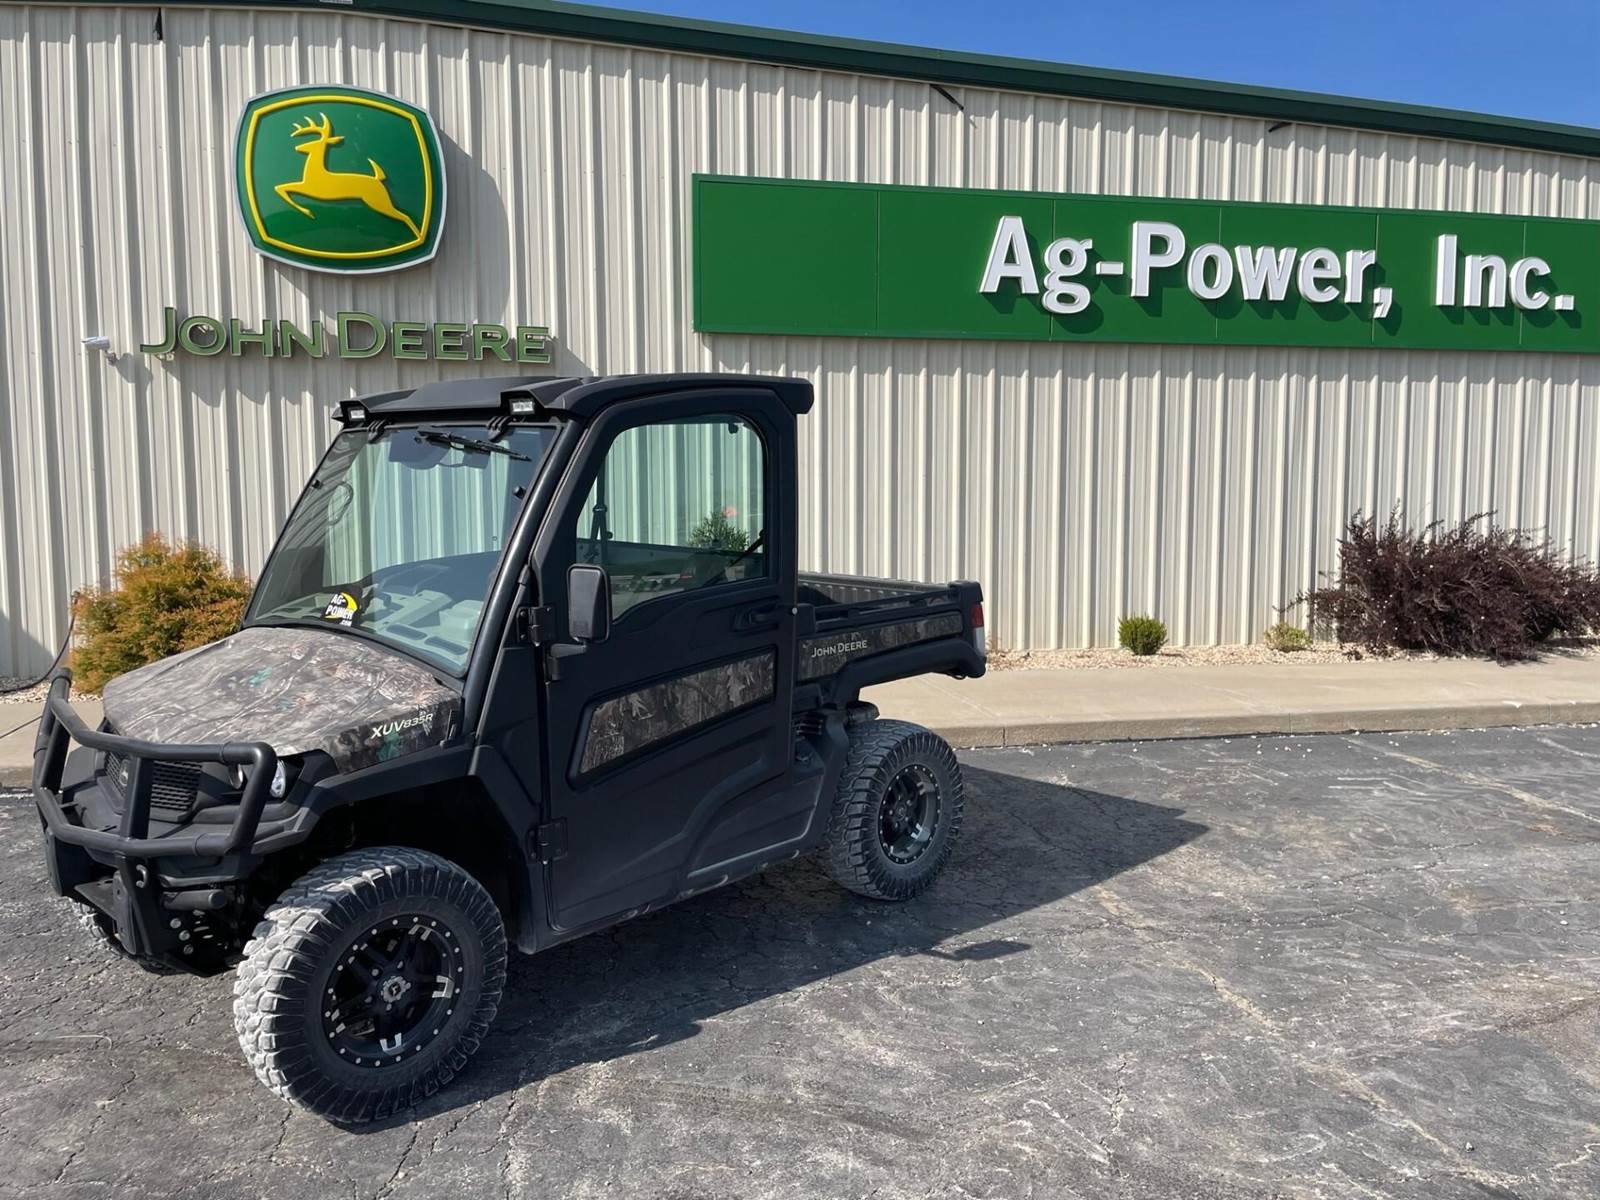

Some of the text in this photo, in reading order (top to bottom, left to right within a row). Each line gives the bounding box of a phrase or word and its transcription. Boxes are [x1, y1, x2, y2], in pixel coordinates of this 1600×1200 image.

[979, 215, 1575, 319] Ag-Power, Inc.
[140, 306, 552, 364] JOHN DEERE
[325, 604, 355, 620] POWER
[811, 640, 868, 658] JOHN DEERE
[370, 713, 434, 739] XUV835R
